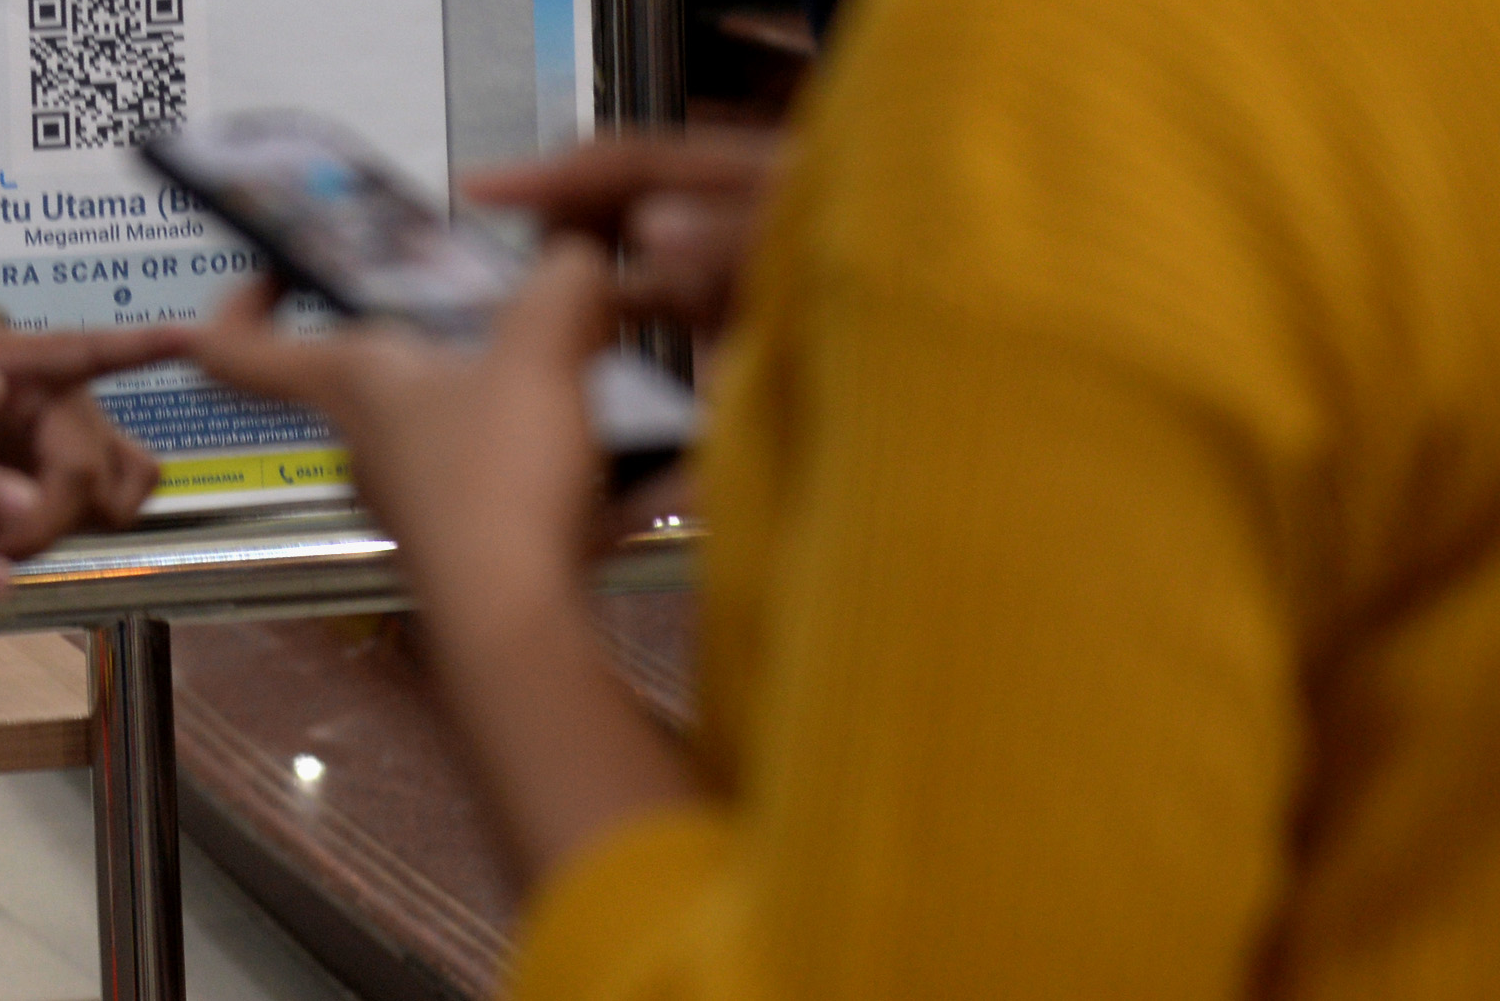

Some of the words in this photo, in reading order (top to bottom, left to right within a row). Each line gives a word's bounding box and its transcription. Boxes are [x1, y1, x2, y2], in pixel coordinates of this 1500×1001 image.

[42, 192, 147, 222] Utama
[24, 225, 121, 248] Megamall
[126, 220, 204, 241] Manado
[52, 259, 130, 283] SCAN
[141, 256, 178, 280] QR
[114, 310, 150, 326] Buat
[158, 306, 197, 322] Akun
